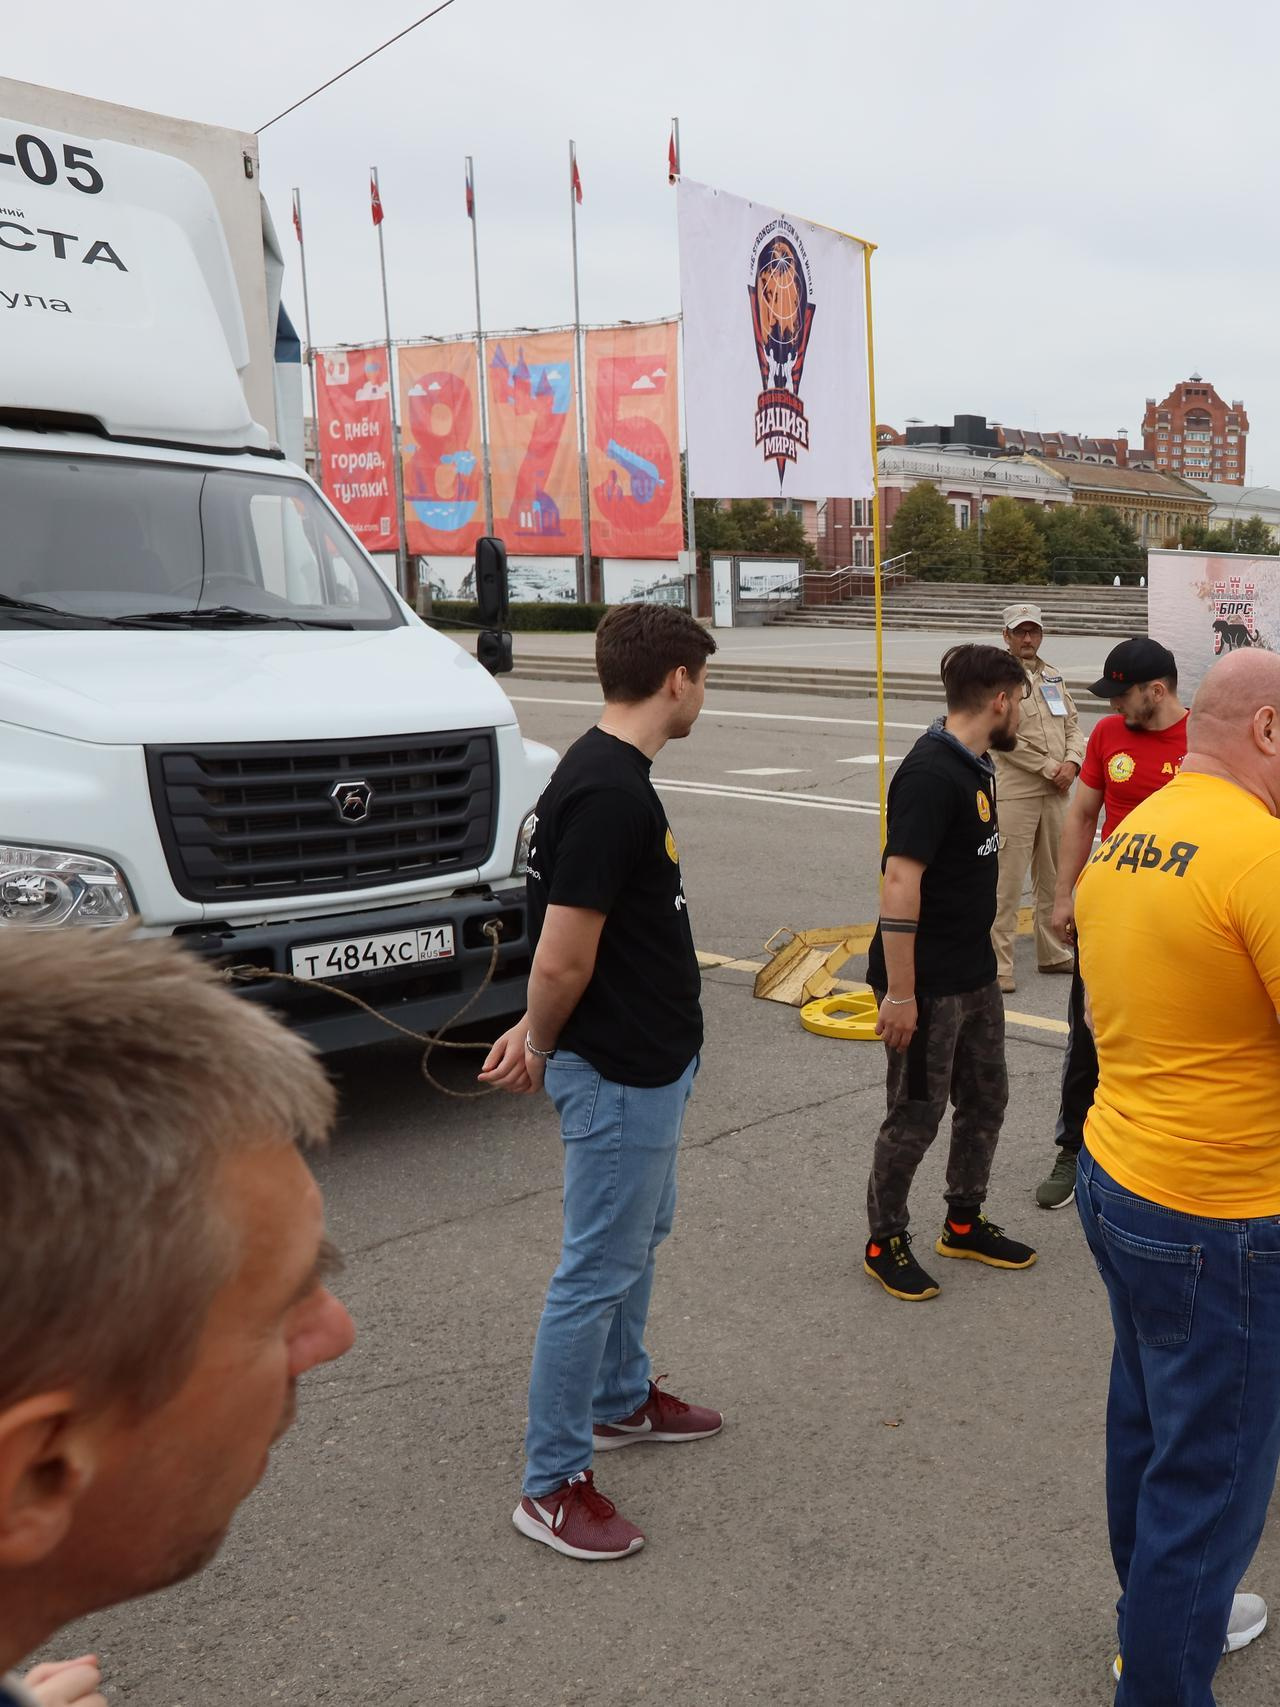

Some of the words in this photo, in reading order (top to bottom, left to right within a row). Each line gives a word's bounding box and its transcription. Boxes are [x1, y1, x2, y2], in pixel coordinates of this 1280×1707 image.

[329, 419, 341, 439] С
[344, 416, 381, 441] днём
[755, 406, 808, 445] НАЦИЯ
[765, 435, 797, 459] МИРА
[330, 450, 386, 474] города,
[332, 476, 389, 504] туляки!
[420, 929, 446, 951] 71
[420, 951, 439, 960] RUS
